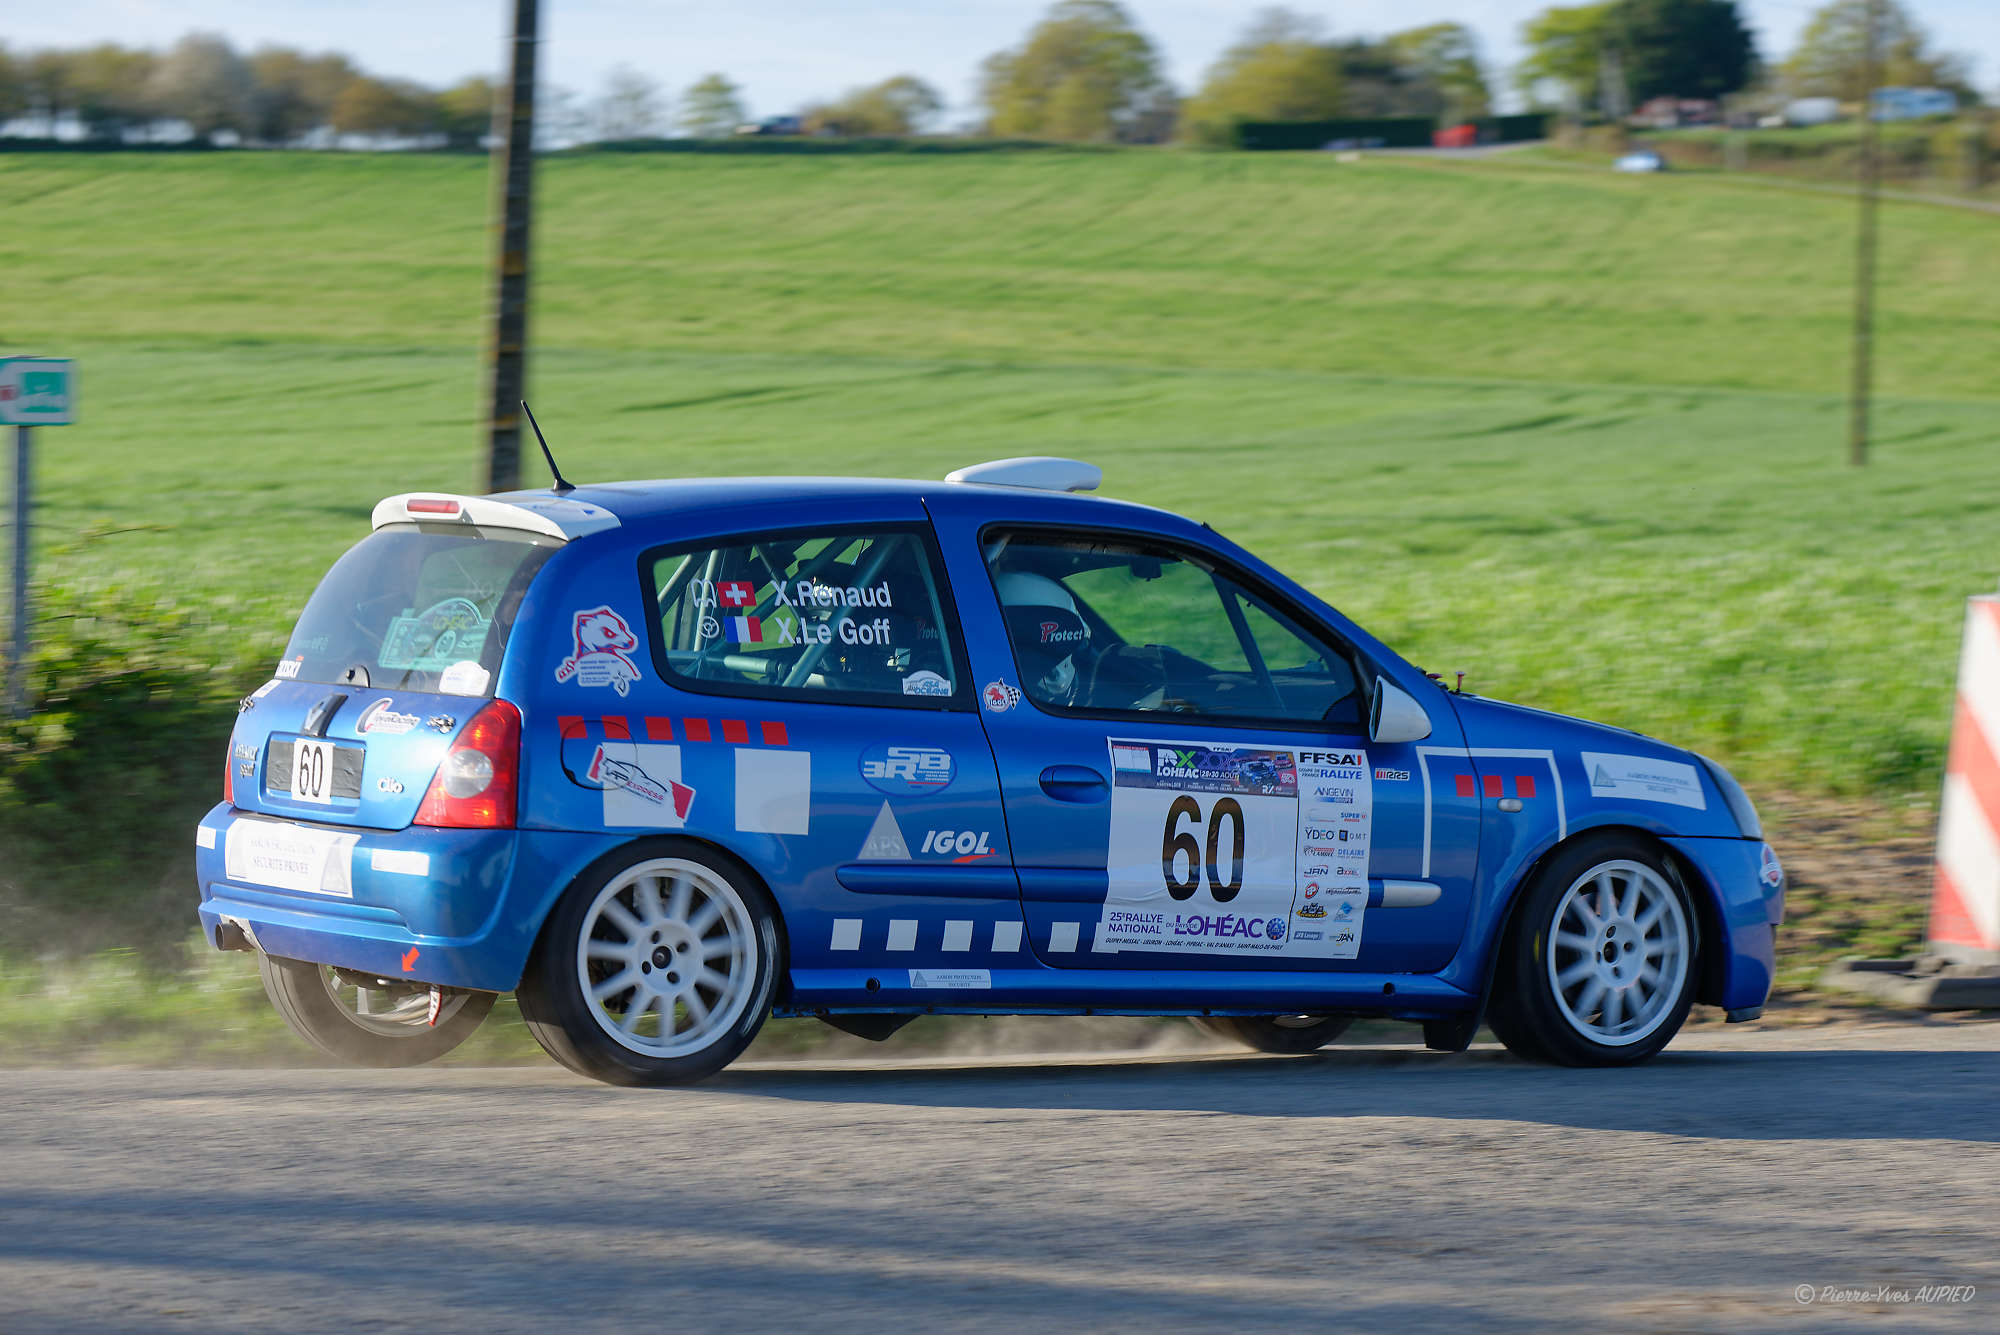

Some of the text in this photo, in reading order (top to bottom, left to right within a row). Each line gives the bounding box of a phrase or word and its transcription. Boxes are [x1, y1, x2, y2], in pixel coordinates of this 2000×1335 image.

[771, 580, 892, 608] X.Renaud
[774, 616, 891, 645] X.Le Goff
[1040, 621, 1084, 643] Protect
[1300, 752, 1356, 766] FFSA
[300, 744, 324, 798] 60
[1157, 766, 1200, 779] LOHEAC
[1320, 769, 1362, 780] RALLYE
[378, 777, 403, 794] Clio
[1313, 787, 1353, 798] ANGEVIN
[1162, 795, 1245, 903] 60
[1125, 912, 1164, 924] RALLYE
[1174, 913, 1265, 939] LOHÉAC
[1108, 923, 1162, 935] NATIONAL
